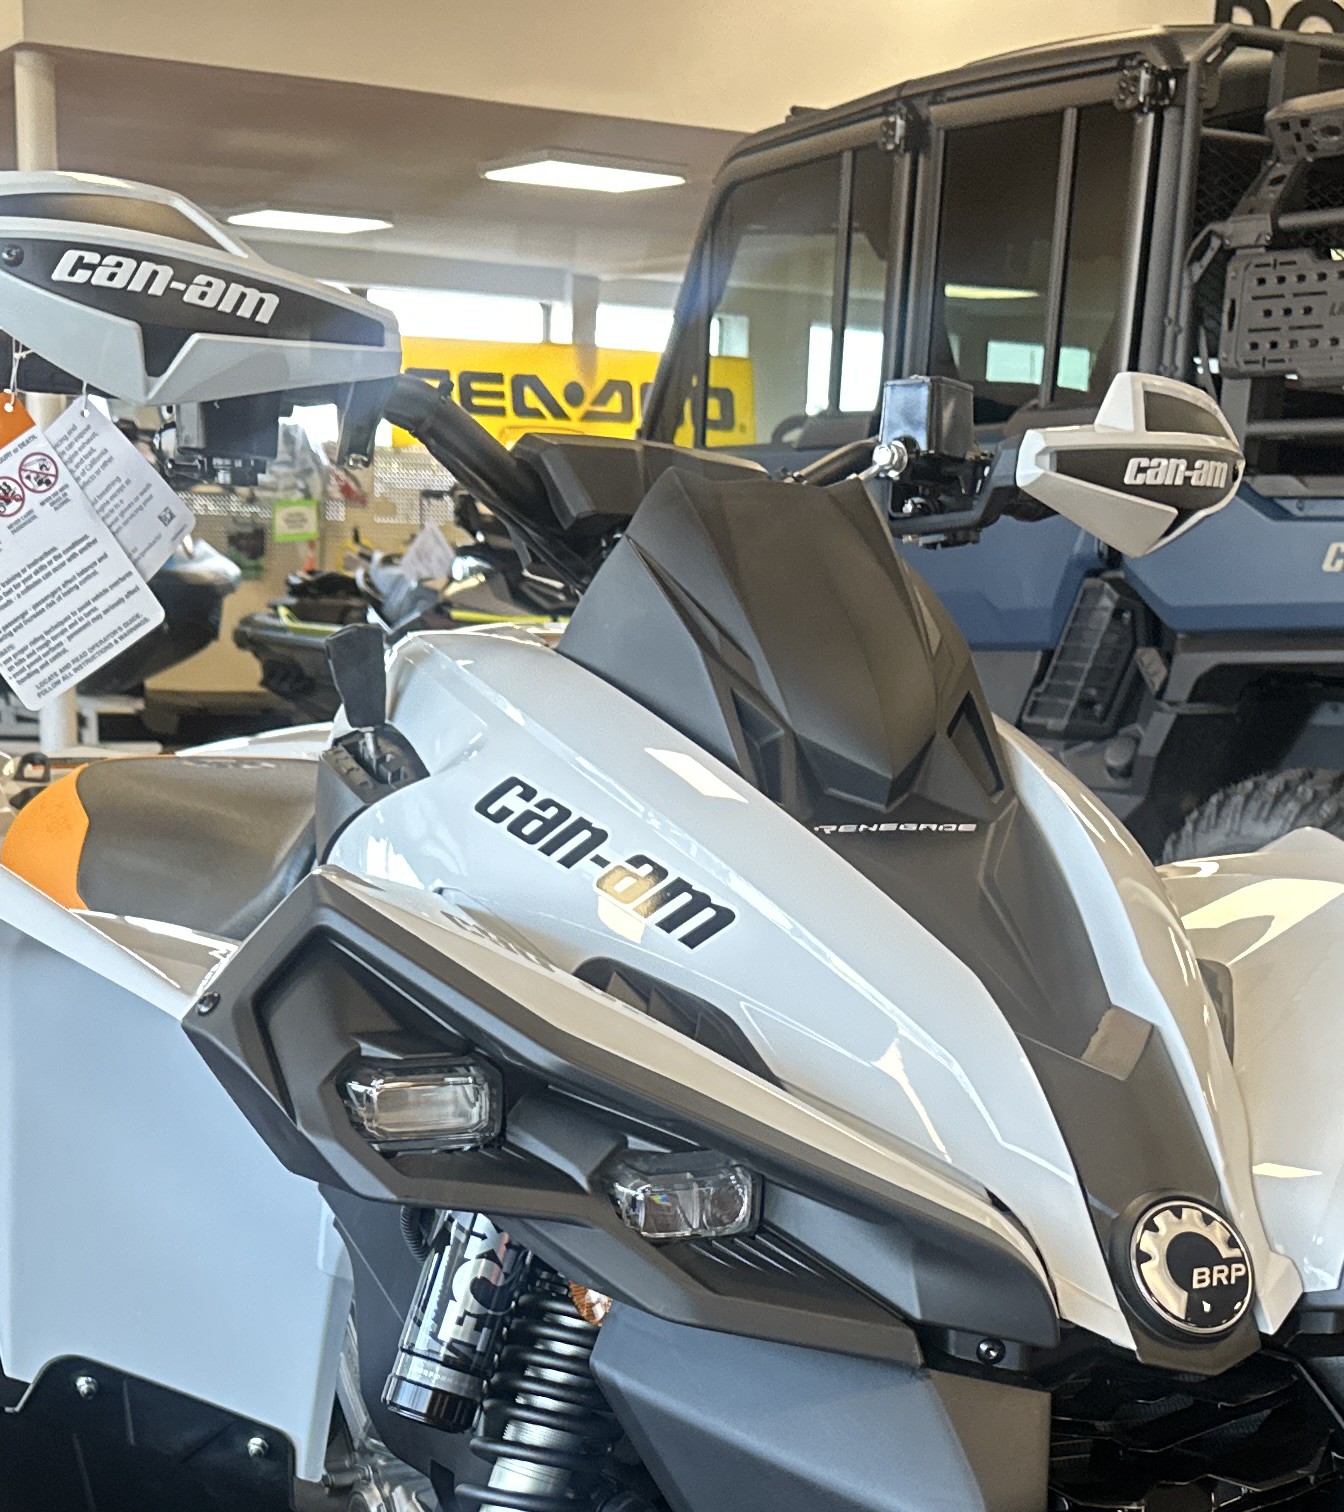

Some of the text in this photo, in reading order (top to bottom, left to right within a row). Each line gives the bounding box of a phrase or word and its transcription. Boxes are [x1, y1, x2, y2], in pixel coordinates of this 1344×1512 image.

[51, 248, 280, 325] can-am
[1123, 457, 1229, 489] can-am
[813, 822, 978, 835] RENEGADE
[473, 775, 738, 951] can-am
[433, 1221, 529, 1357] FOX
[1192, 1263, 1246, 1289] BRP
